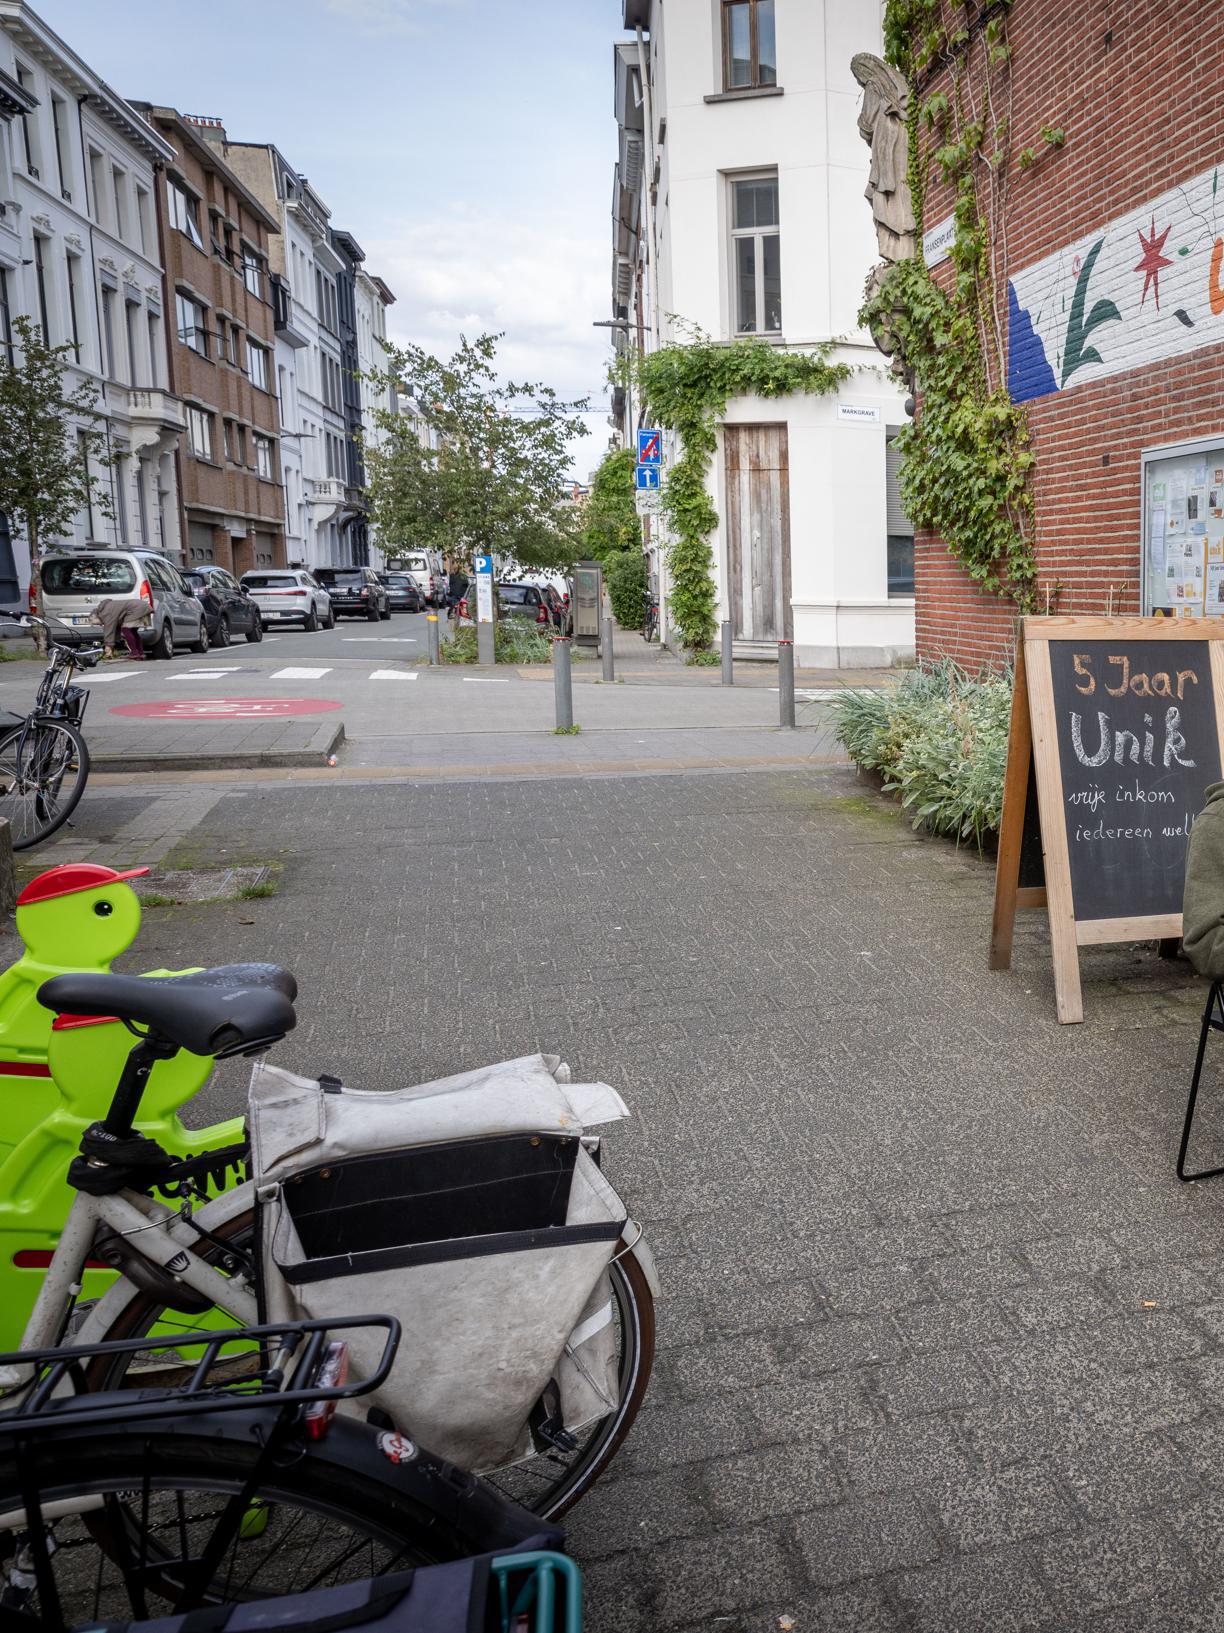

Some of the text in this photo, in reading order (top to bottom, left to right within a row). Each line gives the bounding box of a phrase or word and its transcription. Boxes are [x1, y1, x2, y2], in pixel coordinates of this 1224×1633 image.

[475, 558, 487, 572] P
[1072, 654, 1199, 700] 5 Jaar
[1069, 706, 1197, 768] Unik
[1068, 778, 1175, 812] vrije inkom
[1076, 819, 1152, 841] iedereen
